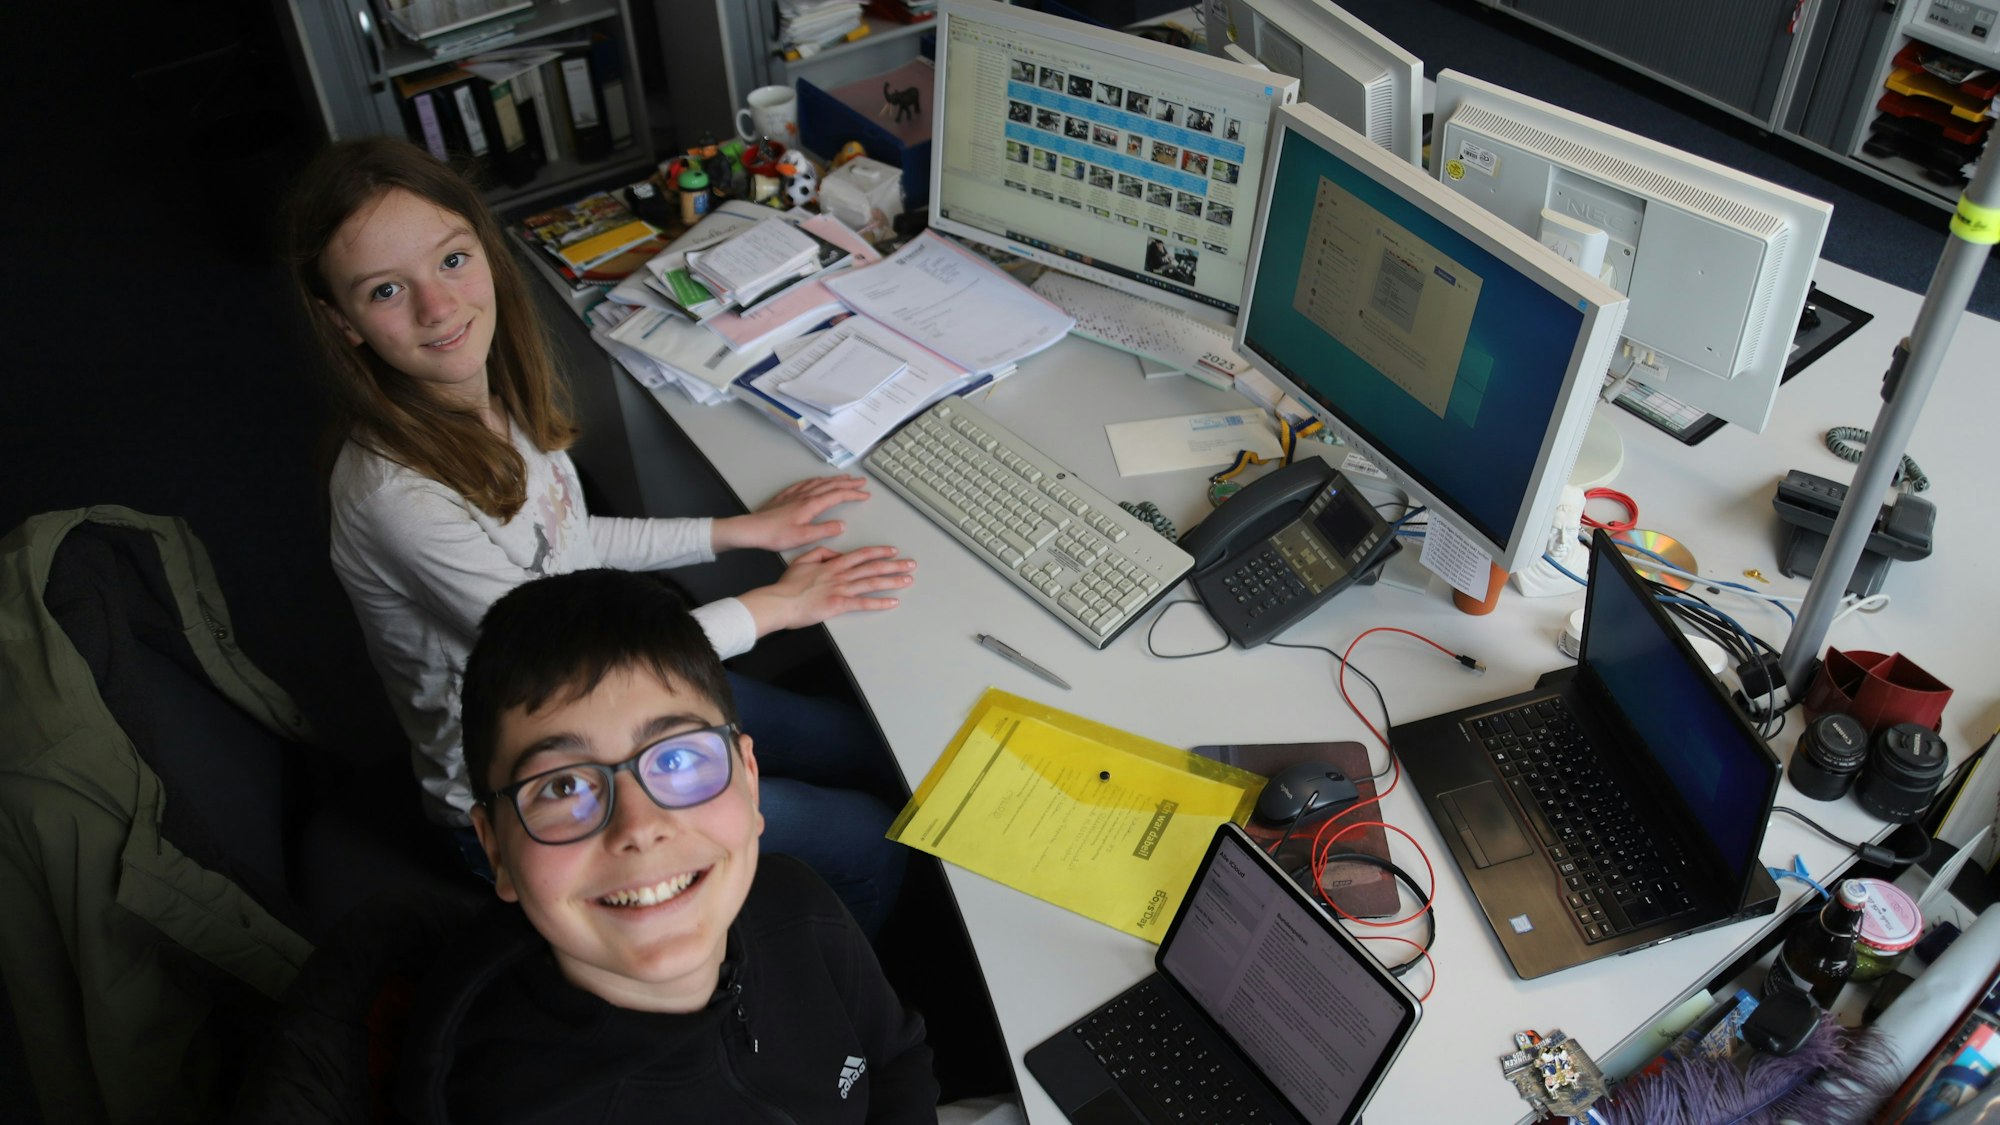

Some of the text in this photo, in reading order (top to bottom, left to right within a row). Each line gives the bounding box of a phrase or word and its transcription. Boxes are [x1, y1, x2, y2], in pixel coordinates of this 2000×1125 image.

[1566, 199, 1625, 231] NEC
[1832, 722, 1852, 745] Canon
[1153, 816, 1166, 831] war
[1229, 861, 1245, 878] iCloud
[840, 1059, 866, 1099] adida
